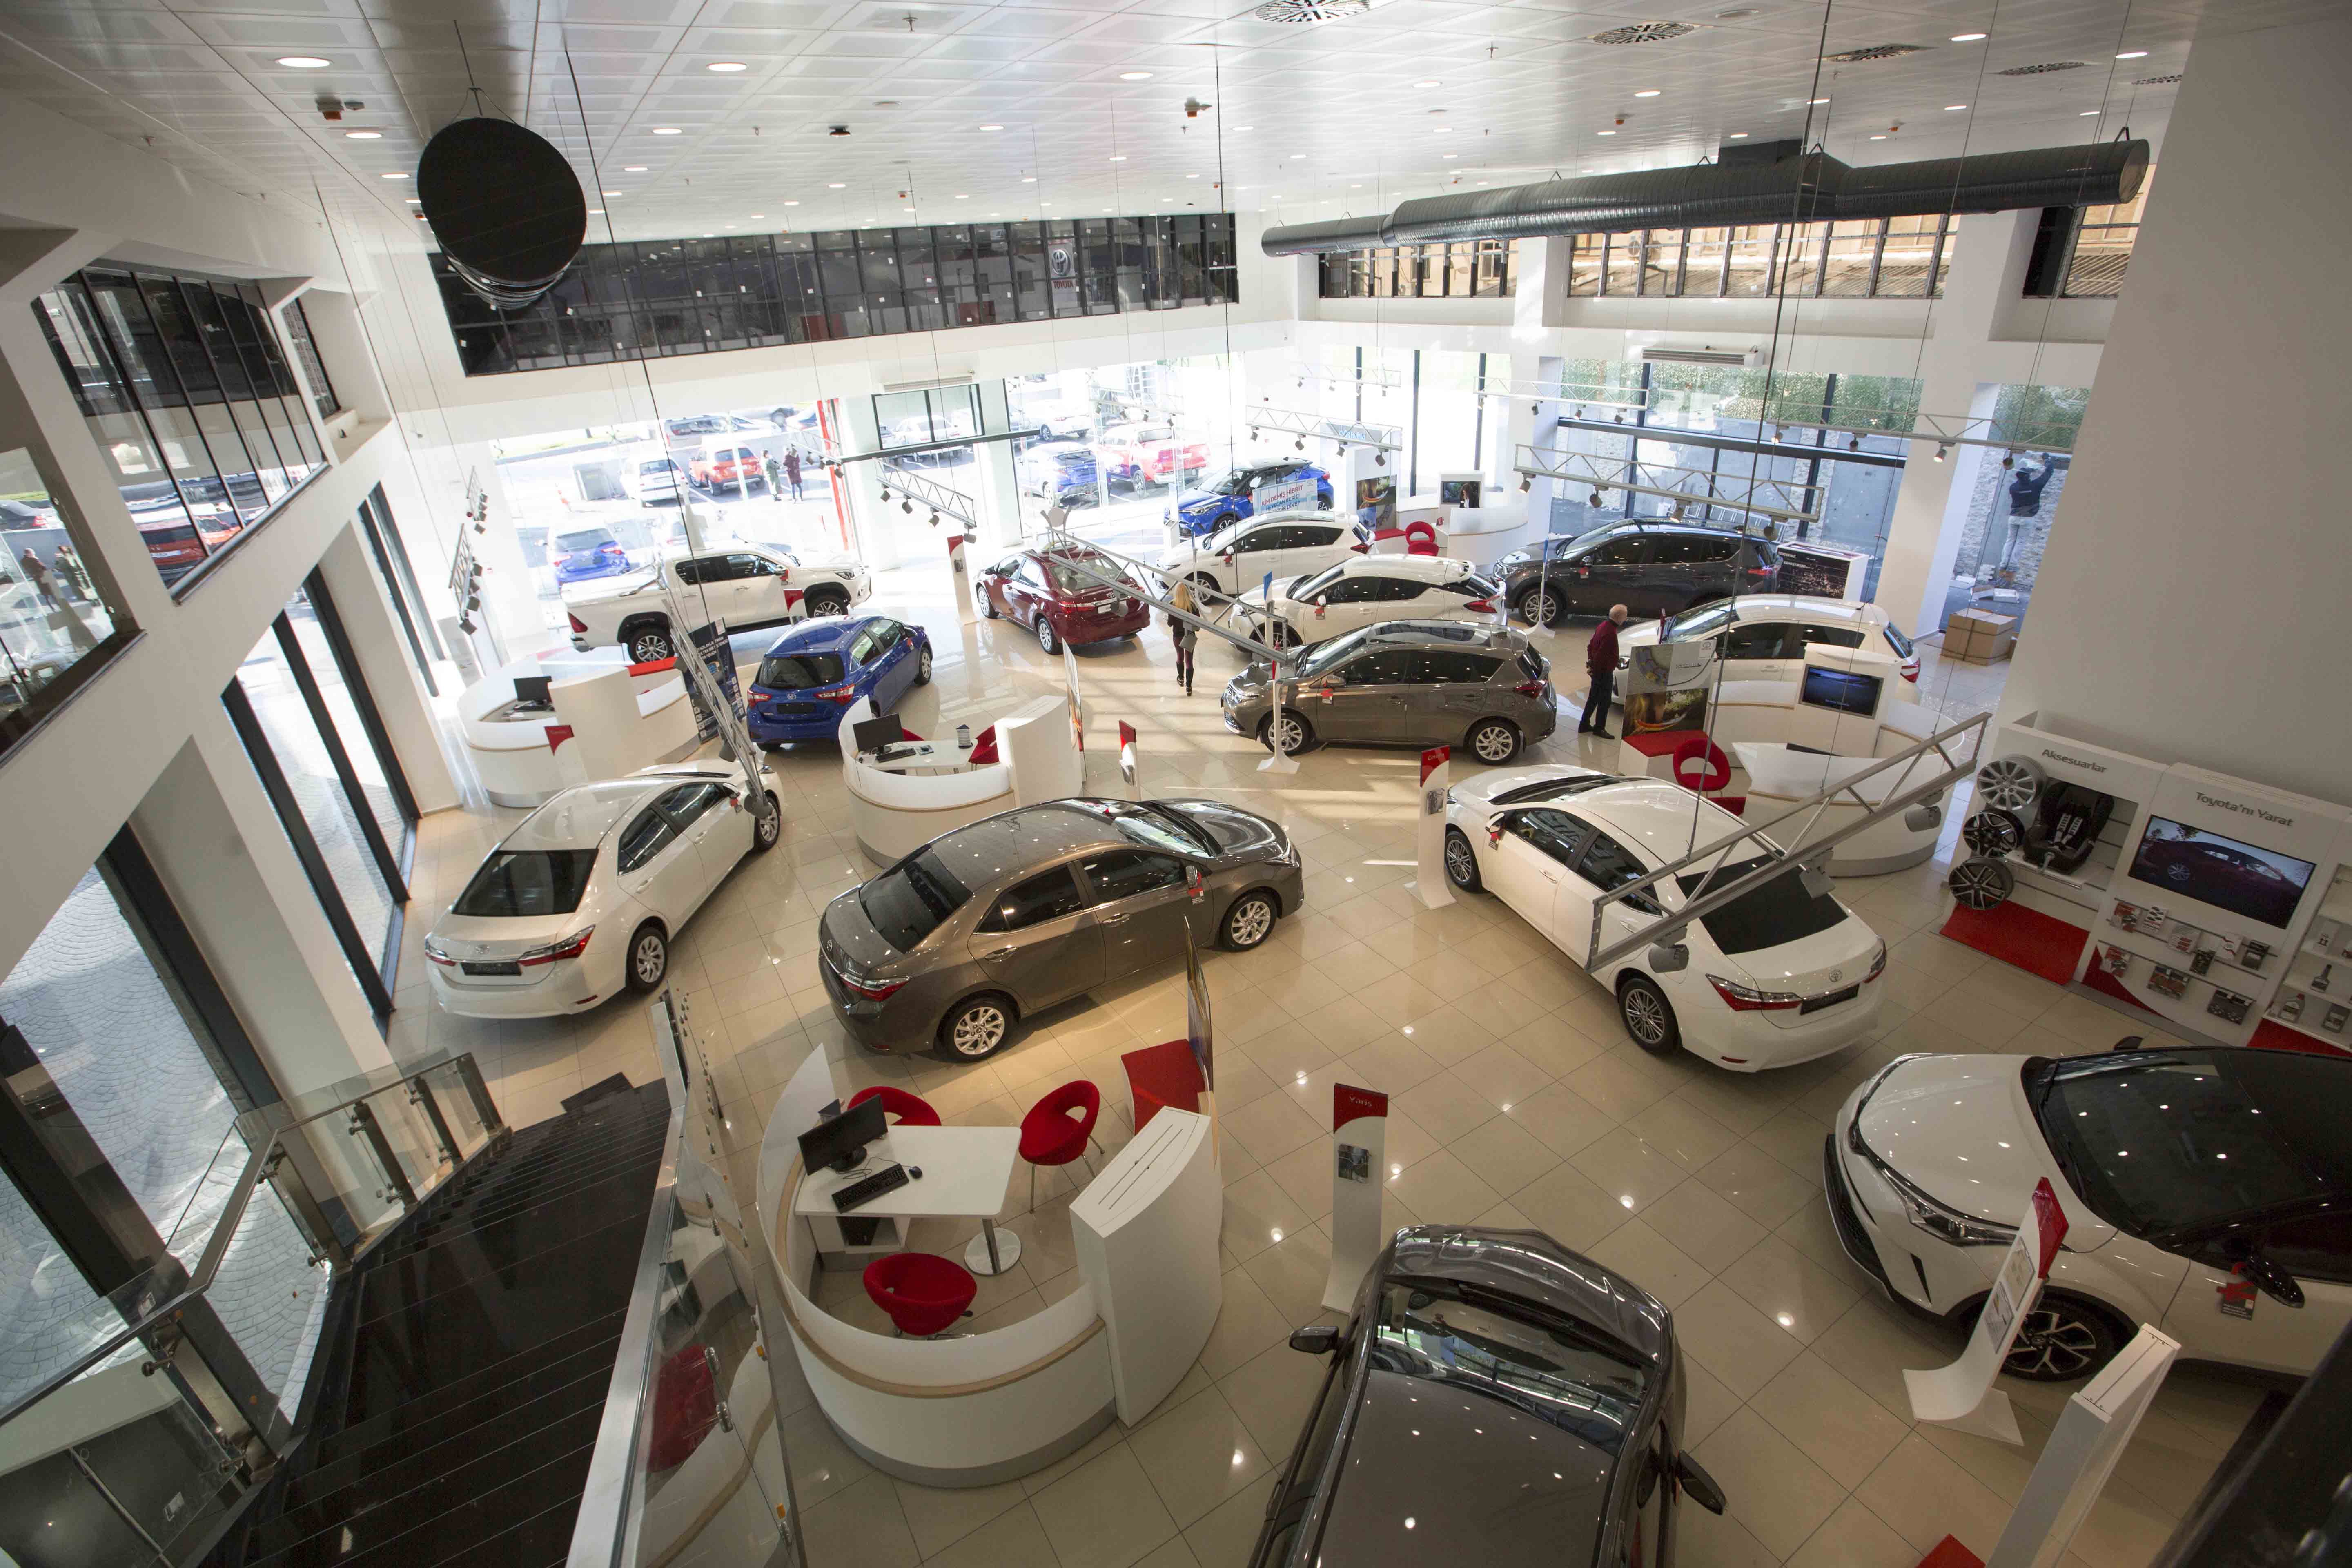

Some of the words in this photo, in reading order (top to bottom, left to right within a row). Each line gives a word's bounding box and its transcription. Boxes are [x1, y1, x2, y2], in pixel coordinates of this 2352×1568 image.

[2041, 749, 2107, 773] Aksesuarlar
[2196, 791, 2254, 816] Toyota'nı
[2258, 809, 2293, 827] Yarat
[1349, 1095, 1372, 1107] Yaris
